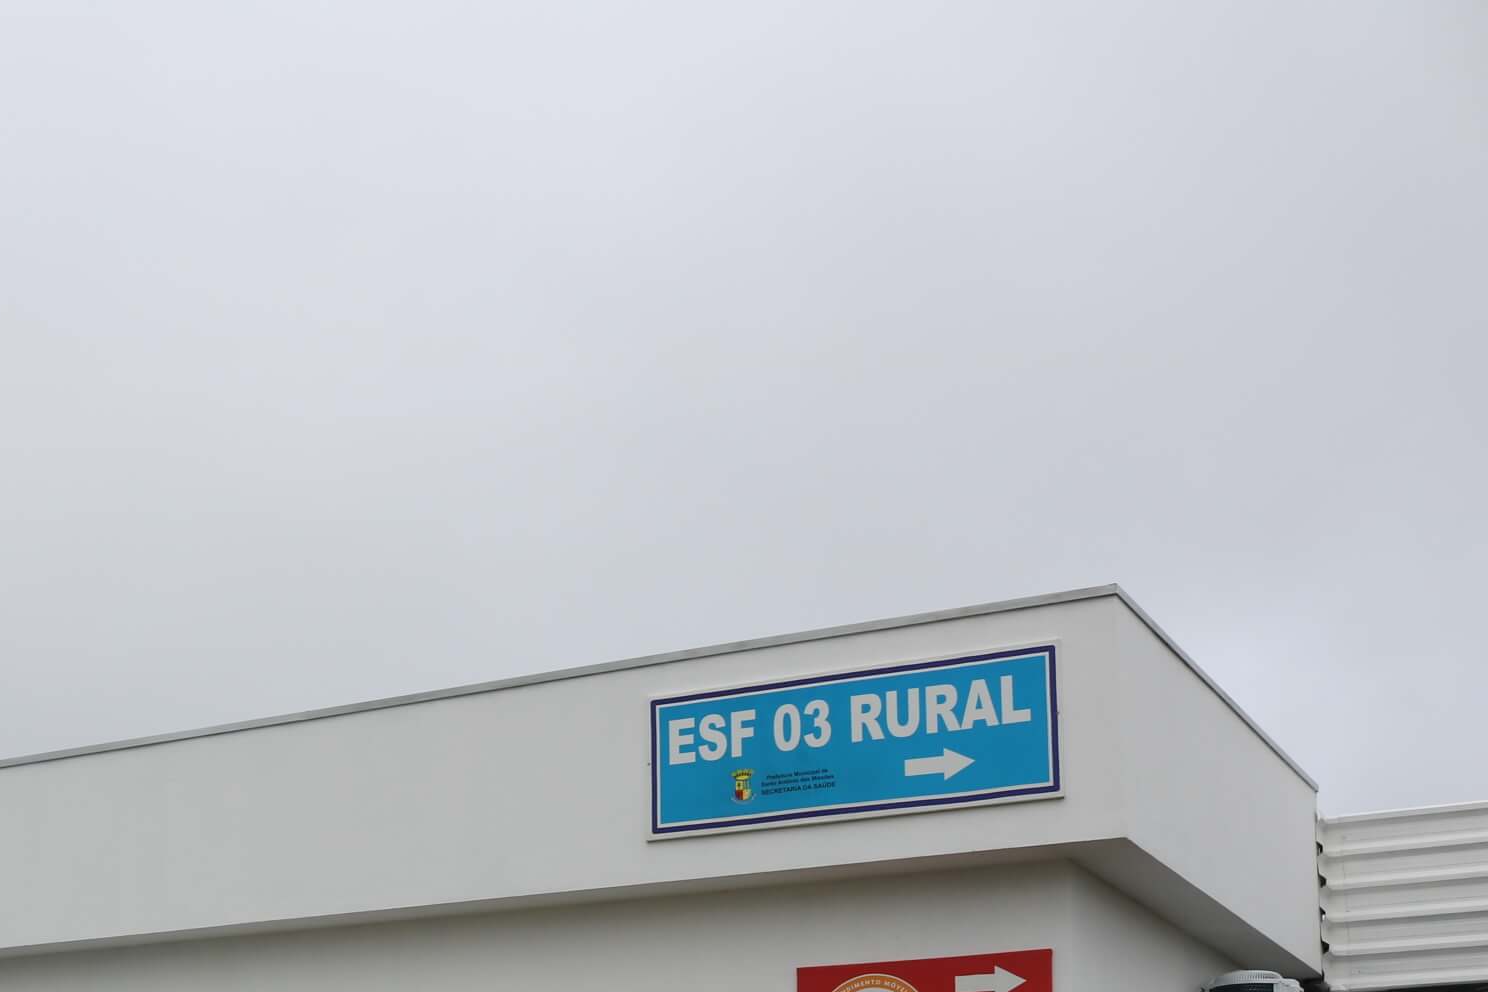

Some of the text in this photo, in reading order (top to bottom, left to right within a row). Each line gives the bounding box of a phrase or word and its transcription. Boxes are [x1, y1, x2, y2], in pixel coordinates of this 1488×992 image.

[668, 675, 1032, 765] ESF 03 RURAL
